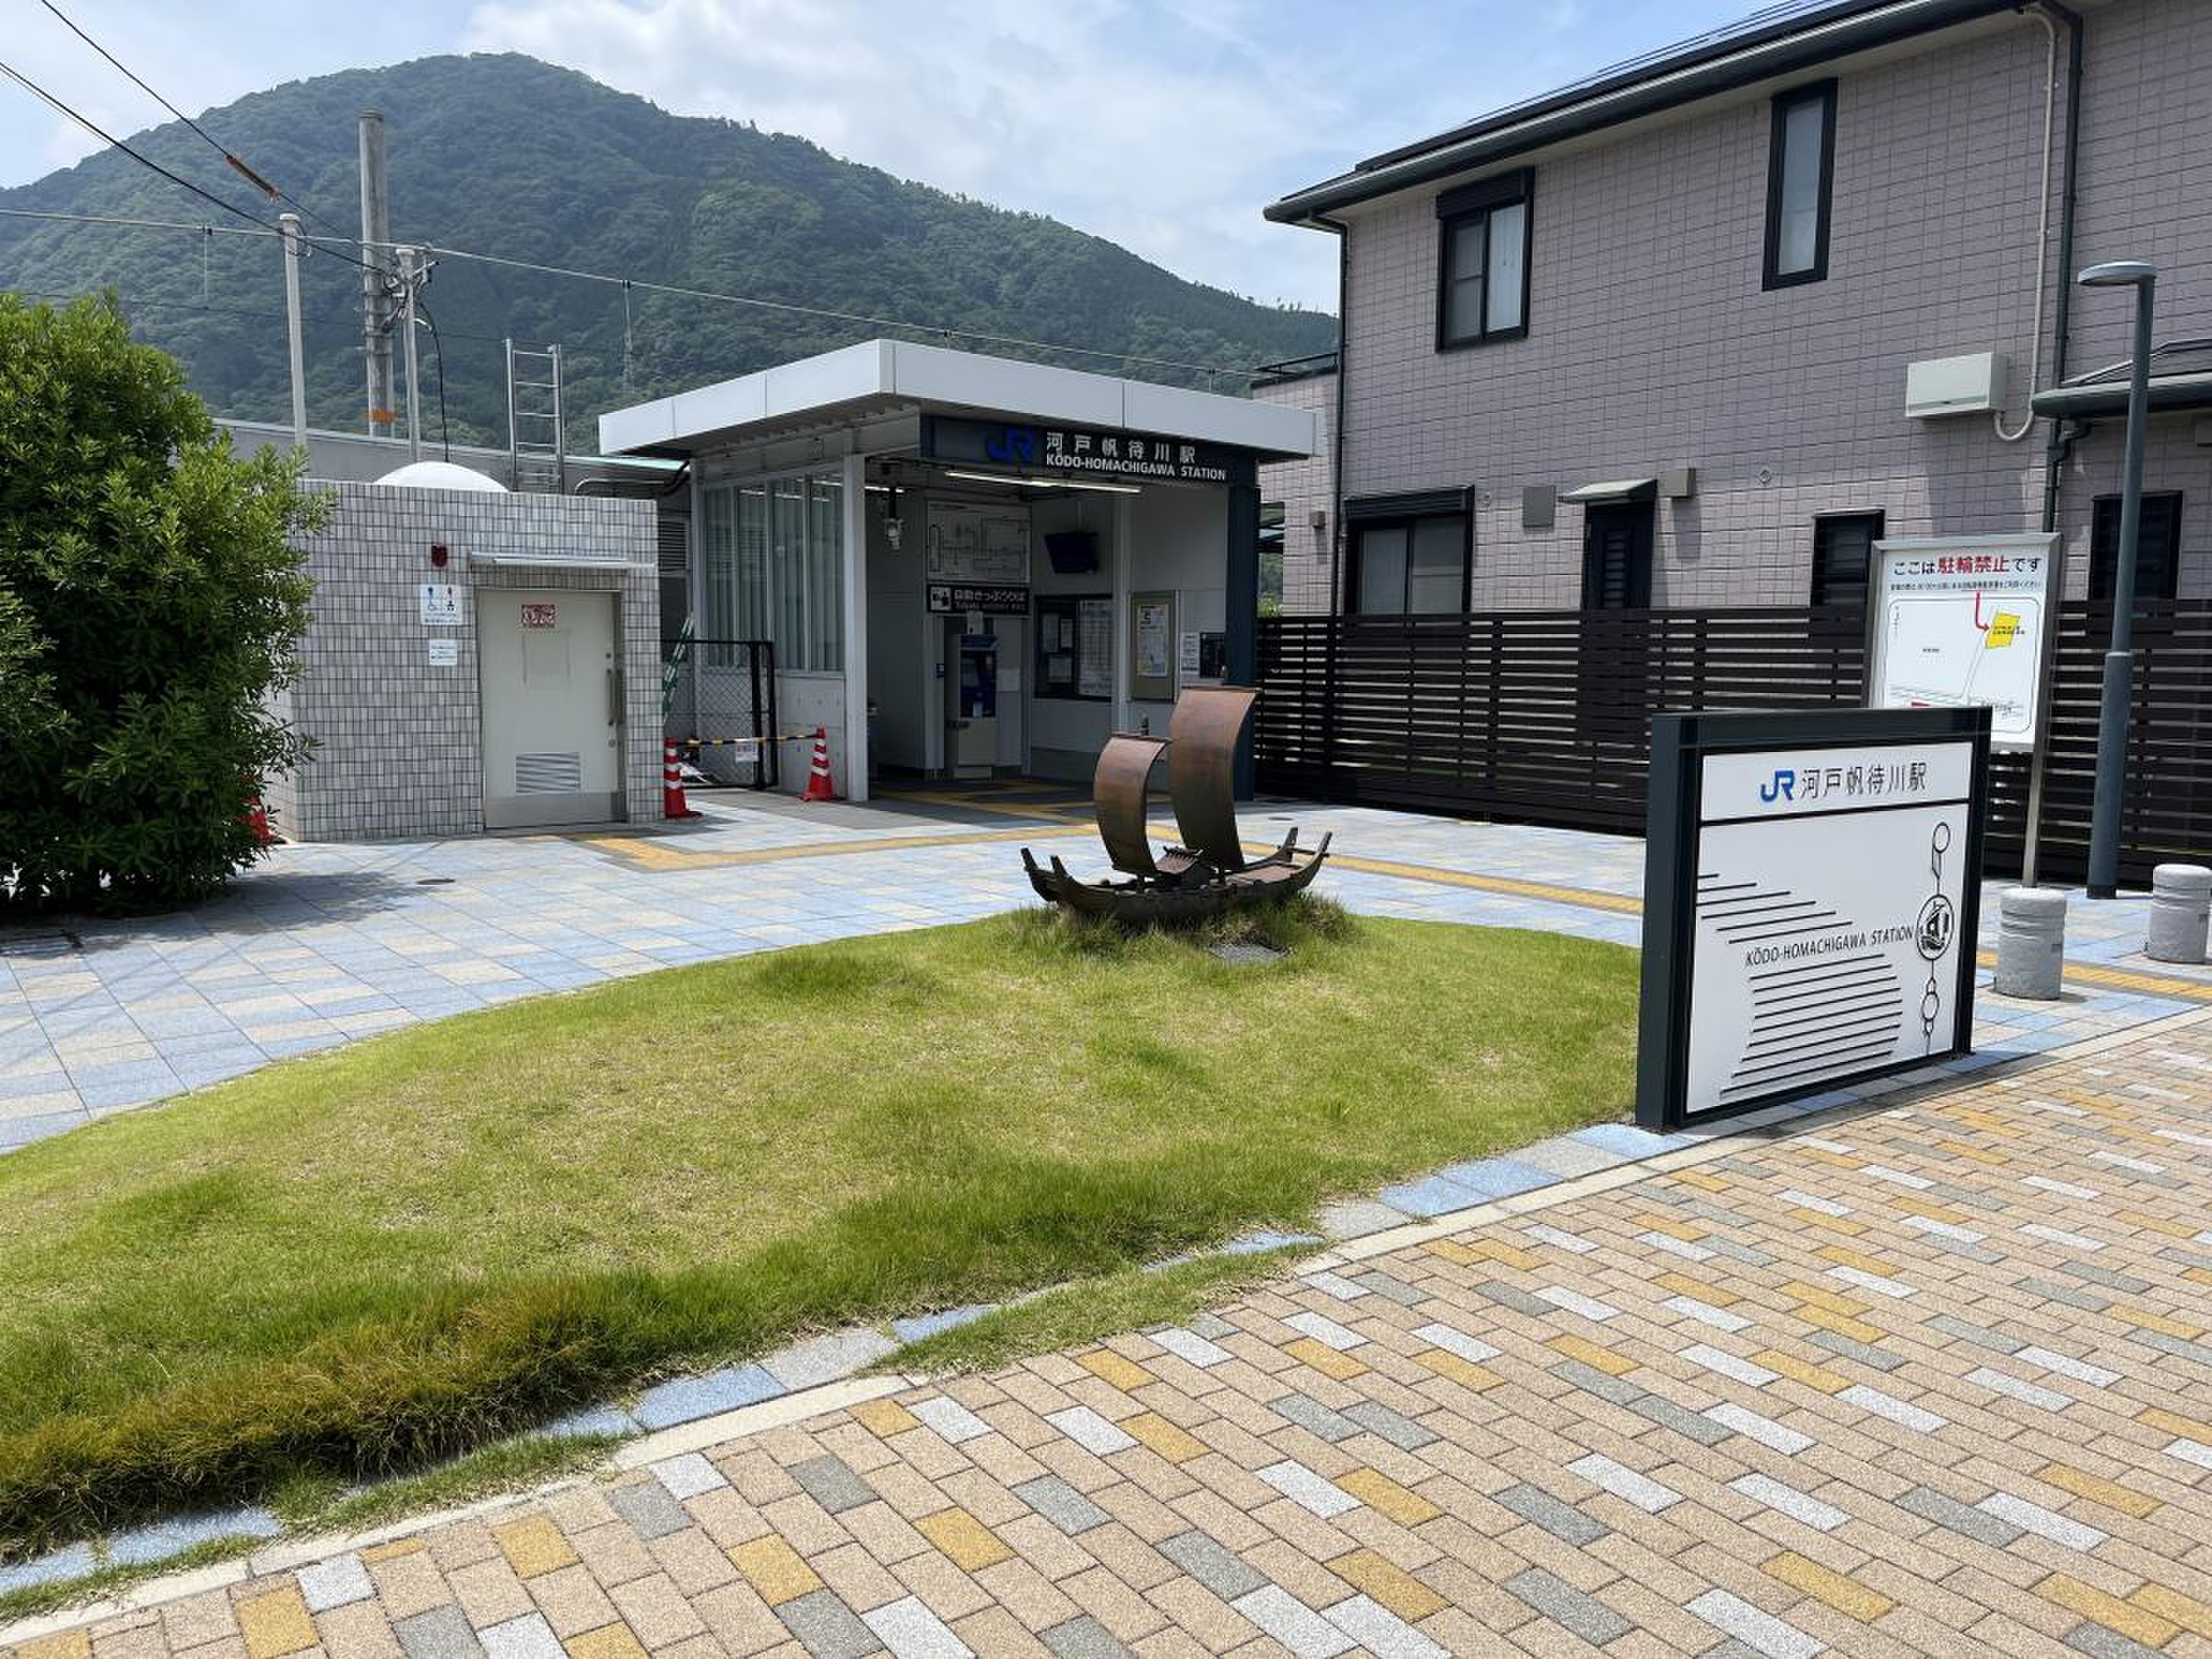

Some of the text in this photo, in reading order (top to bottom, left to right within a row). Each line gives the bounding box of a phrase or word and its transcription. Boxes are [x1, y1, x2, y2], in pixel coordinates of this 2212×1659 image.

[986, 428, 1196, 465] JR 河戸帆待川駅
[1181, 465, 1226, 481] STATION
[1894, 555, 2041, 575] ここは駐輪禁止です
[1760, 762, 1926, 802] JR 河戸帆待川駅
[1871, 925, 1913, 944] STATION
